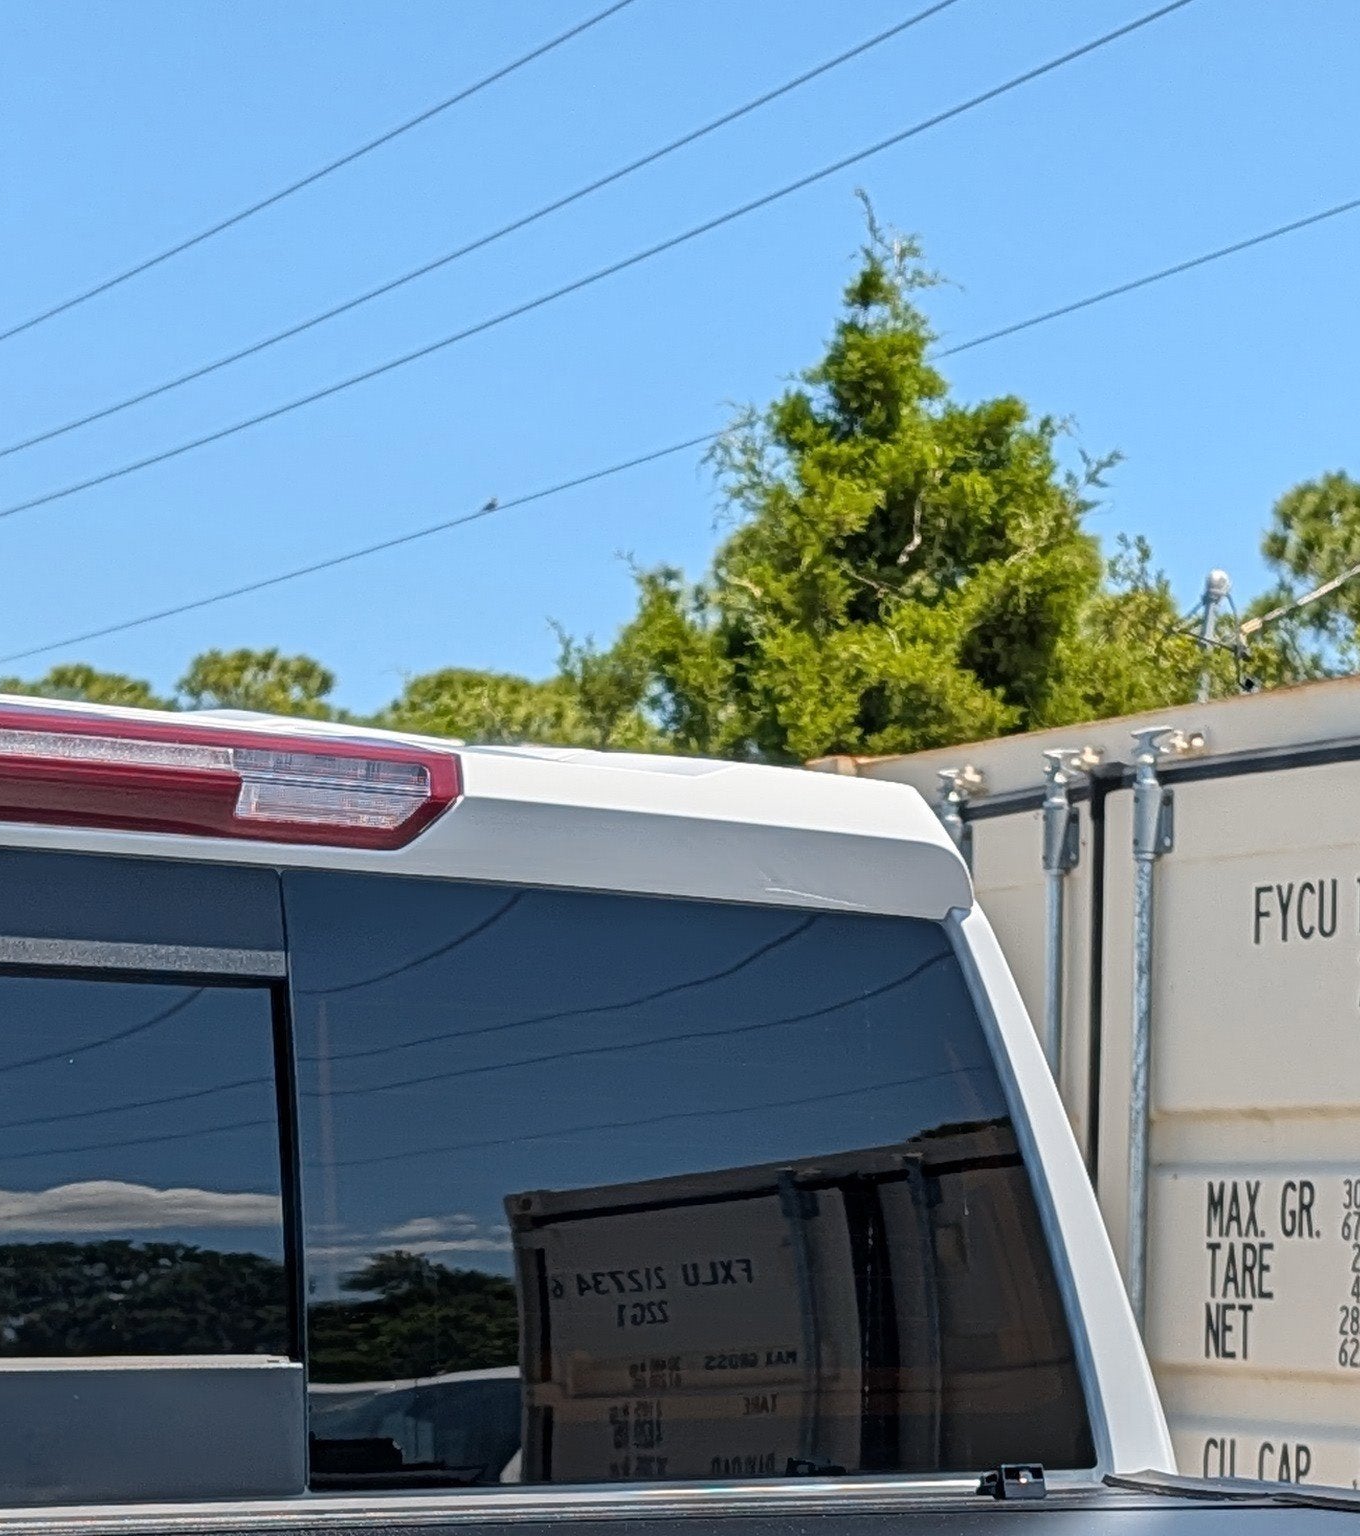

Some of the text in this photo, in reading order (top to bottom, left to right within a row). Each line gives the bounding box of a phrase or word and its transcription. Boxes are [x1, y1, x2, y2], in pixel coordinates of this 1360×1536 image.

[1253, 878, 1338, 945] FYCU
[1206, 1180, 1266, 1238] MAX.
[1280, 1180, 1321, 1239] GR.
[1206, 1241, 1274, 1300] TARE
[1204, 1302, 1254, 1360] NET
